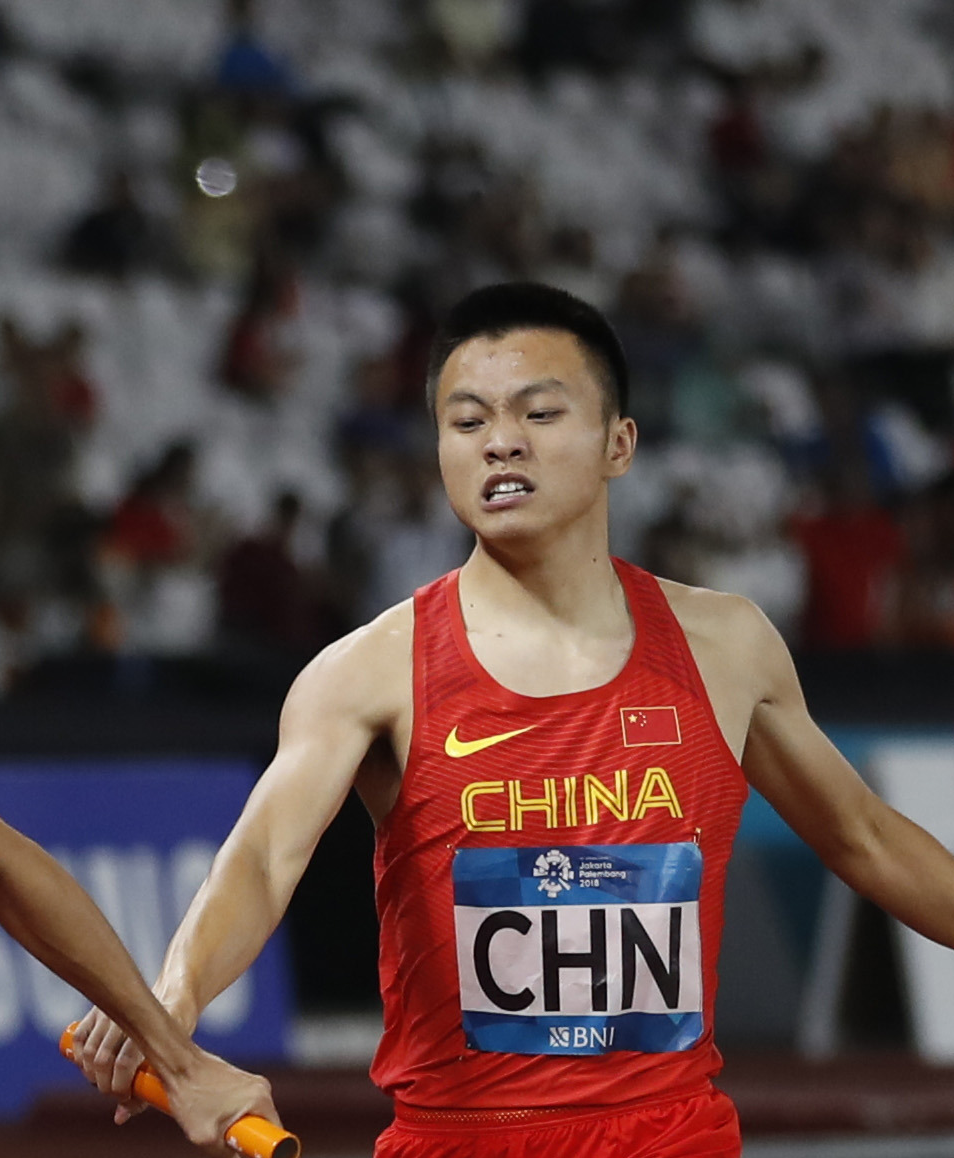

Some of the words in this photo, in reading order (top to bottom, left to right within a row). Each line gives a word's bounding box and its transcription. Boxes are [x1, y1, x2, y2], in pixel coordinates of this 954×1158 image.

[460, 767, 684, 833] CHINA
[579, 862, 612, 870] Jakarta
[579, 871, 627, 880] Palembang
[579, 880, 600, 888] 2018
[473, 906, 683, 1012] CHN
[573, 1026, 615, 1048] BNI
